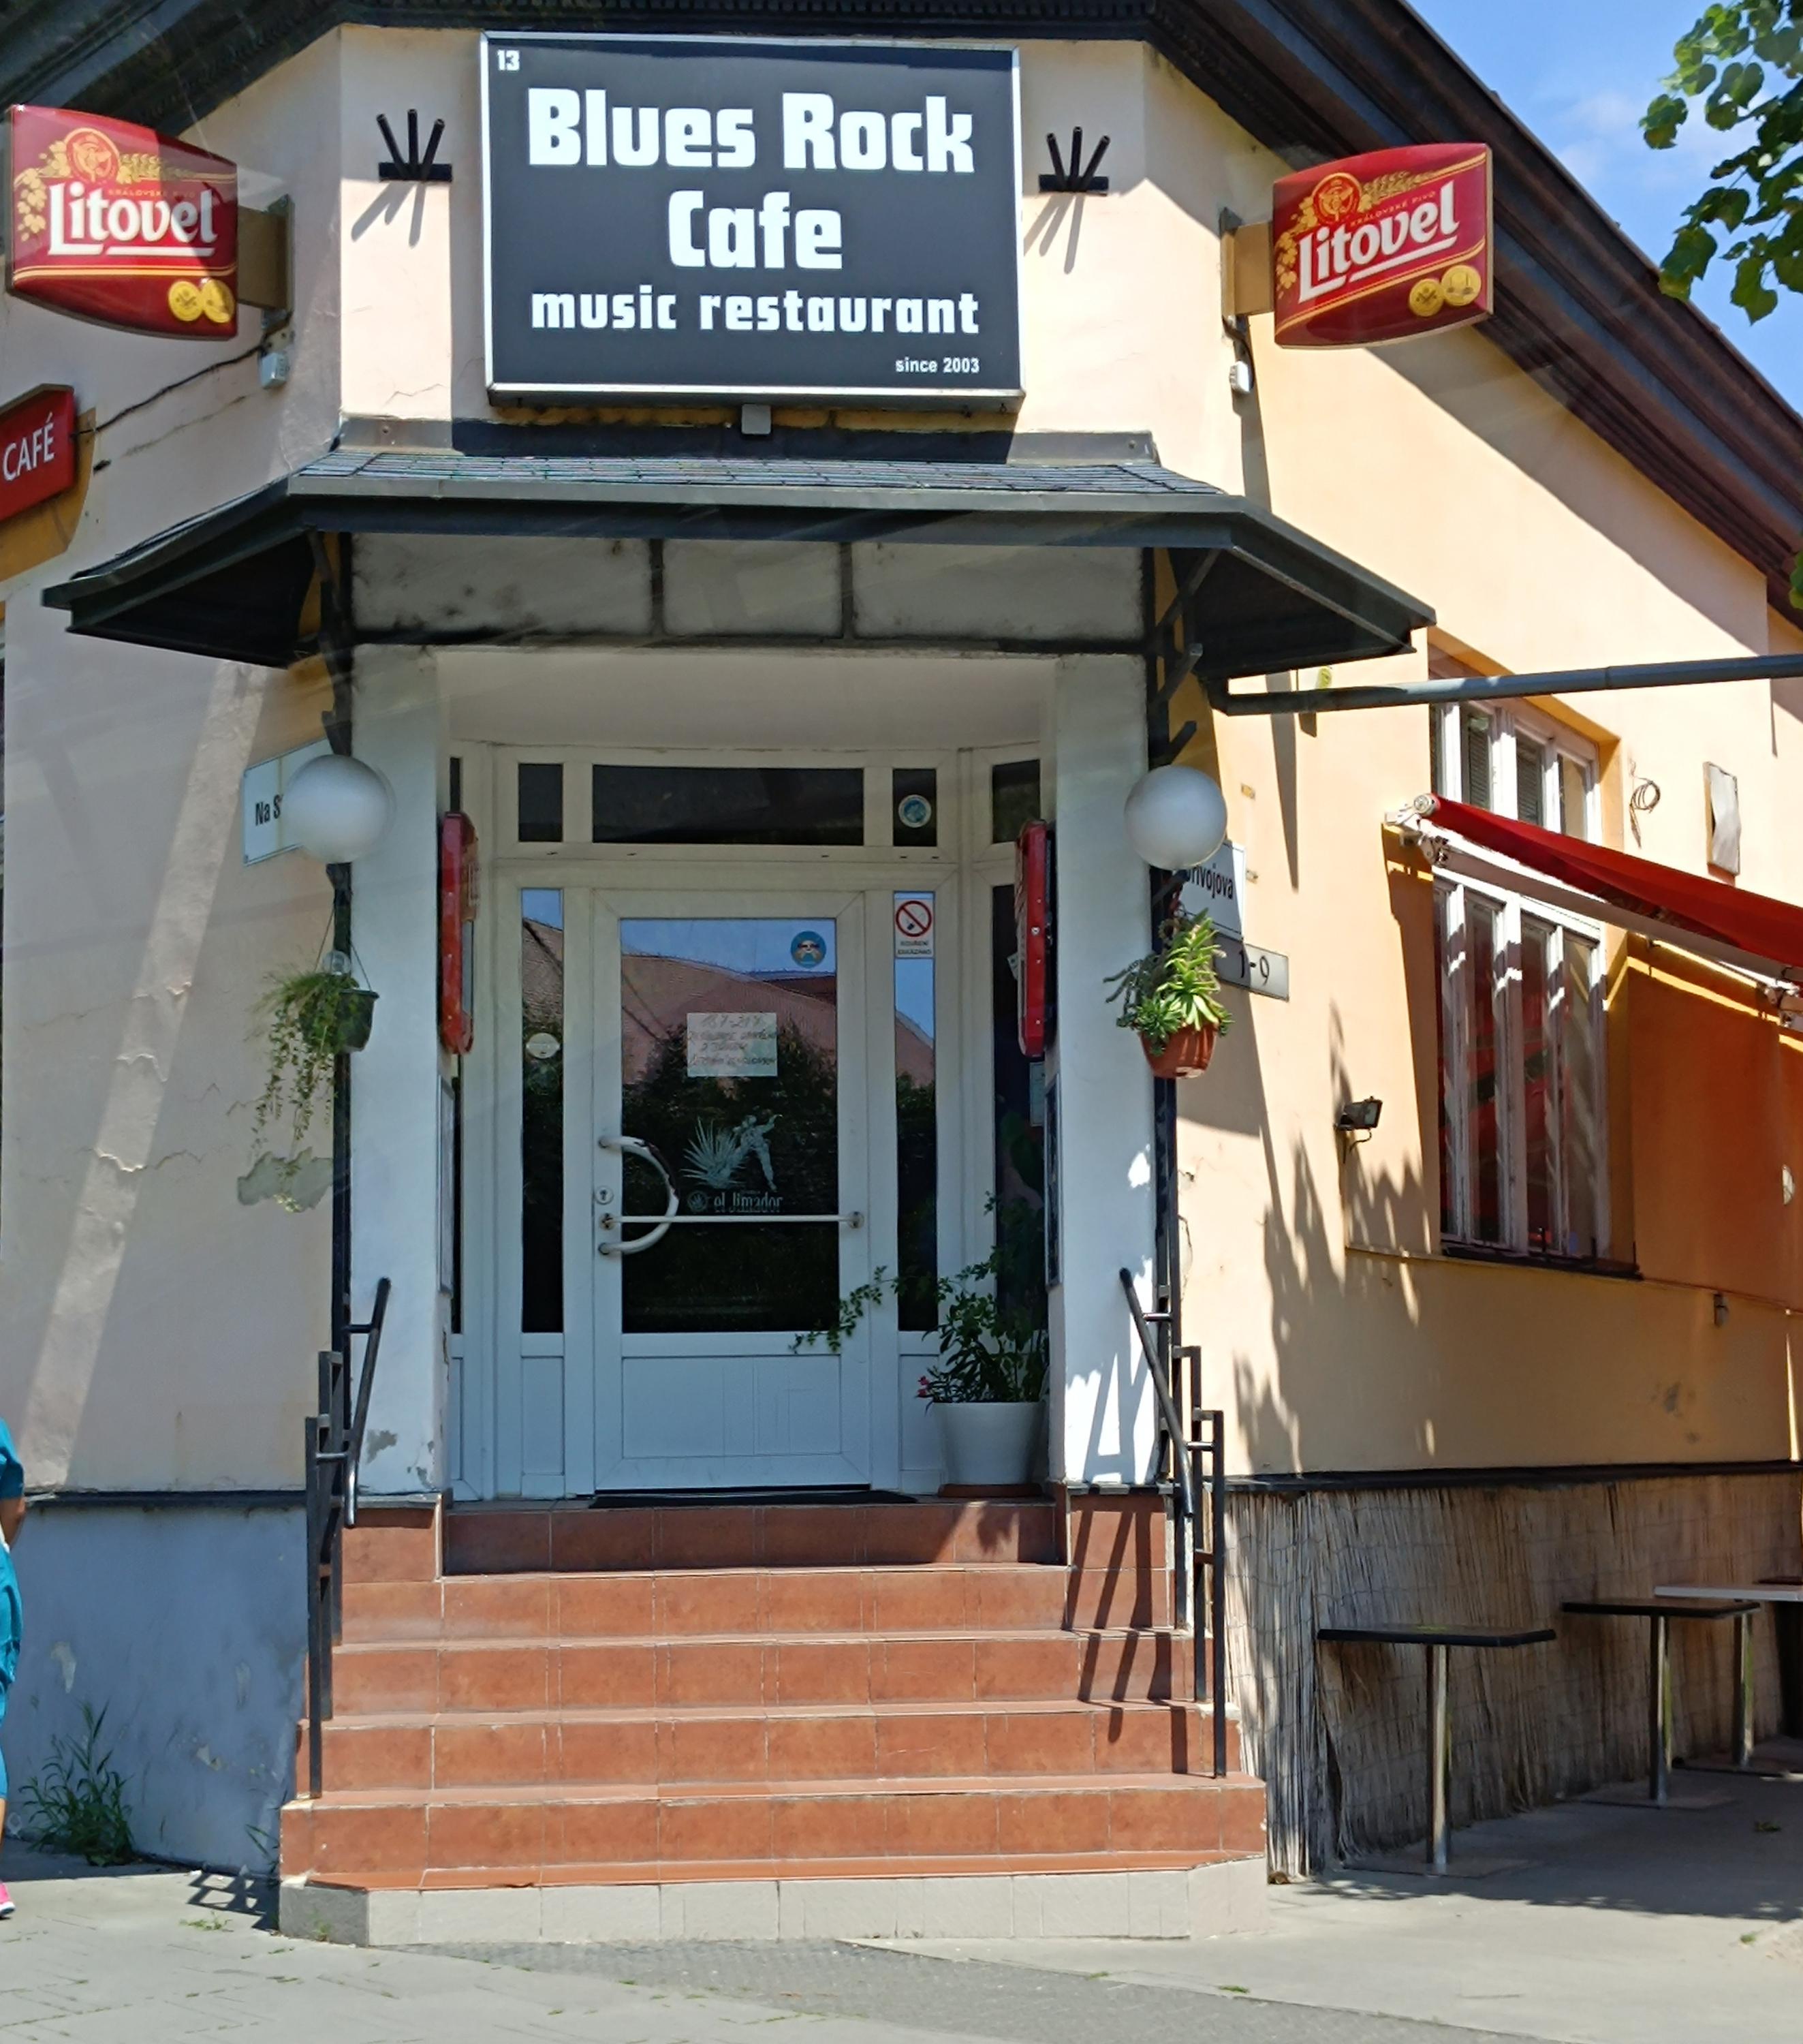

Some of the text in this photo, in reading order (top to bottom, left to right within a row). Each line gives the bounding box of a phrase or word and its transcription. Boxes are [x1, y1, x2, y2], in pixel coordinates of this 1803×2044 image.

[497, 50, 520, 71] 13
[529, 88, 974, 172] Blues Rock
[48, 181, 218, 256] Litovel
[669, 191, 842, 269] Cafe
[1298, 181, 1460, 303] Litovel
[532, 285, 978, 333] music restaurant
[896, 357, 979, 373] since 2003
[3, 412, 56, 483] CAFÉ
[255, 794, 284, 826] Na S
[714, 1192, 725, 1213] el
